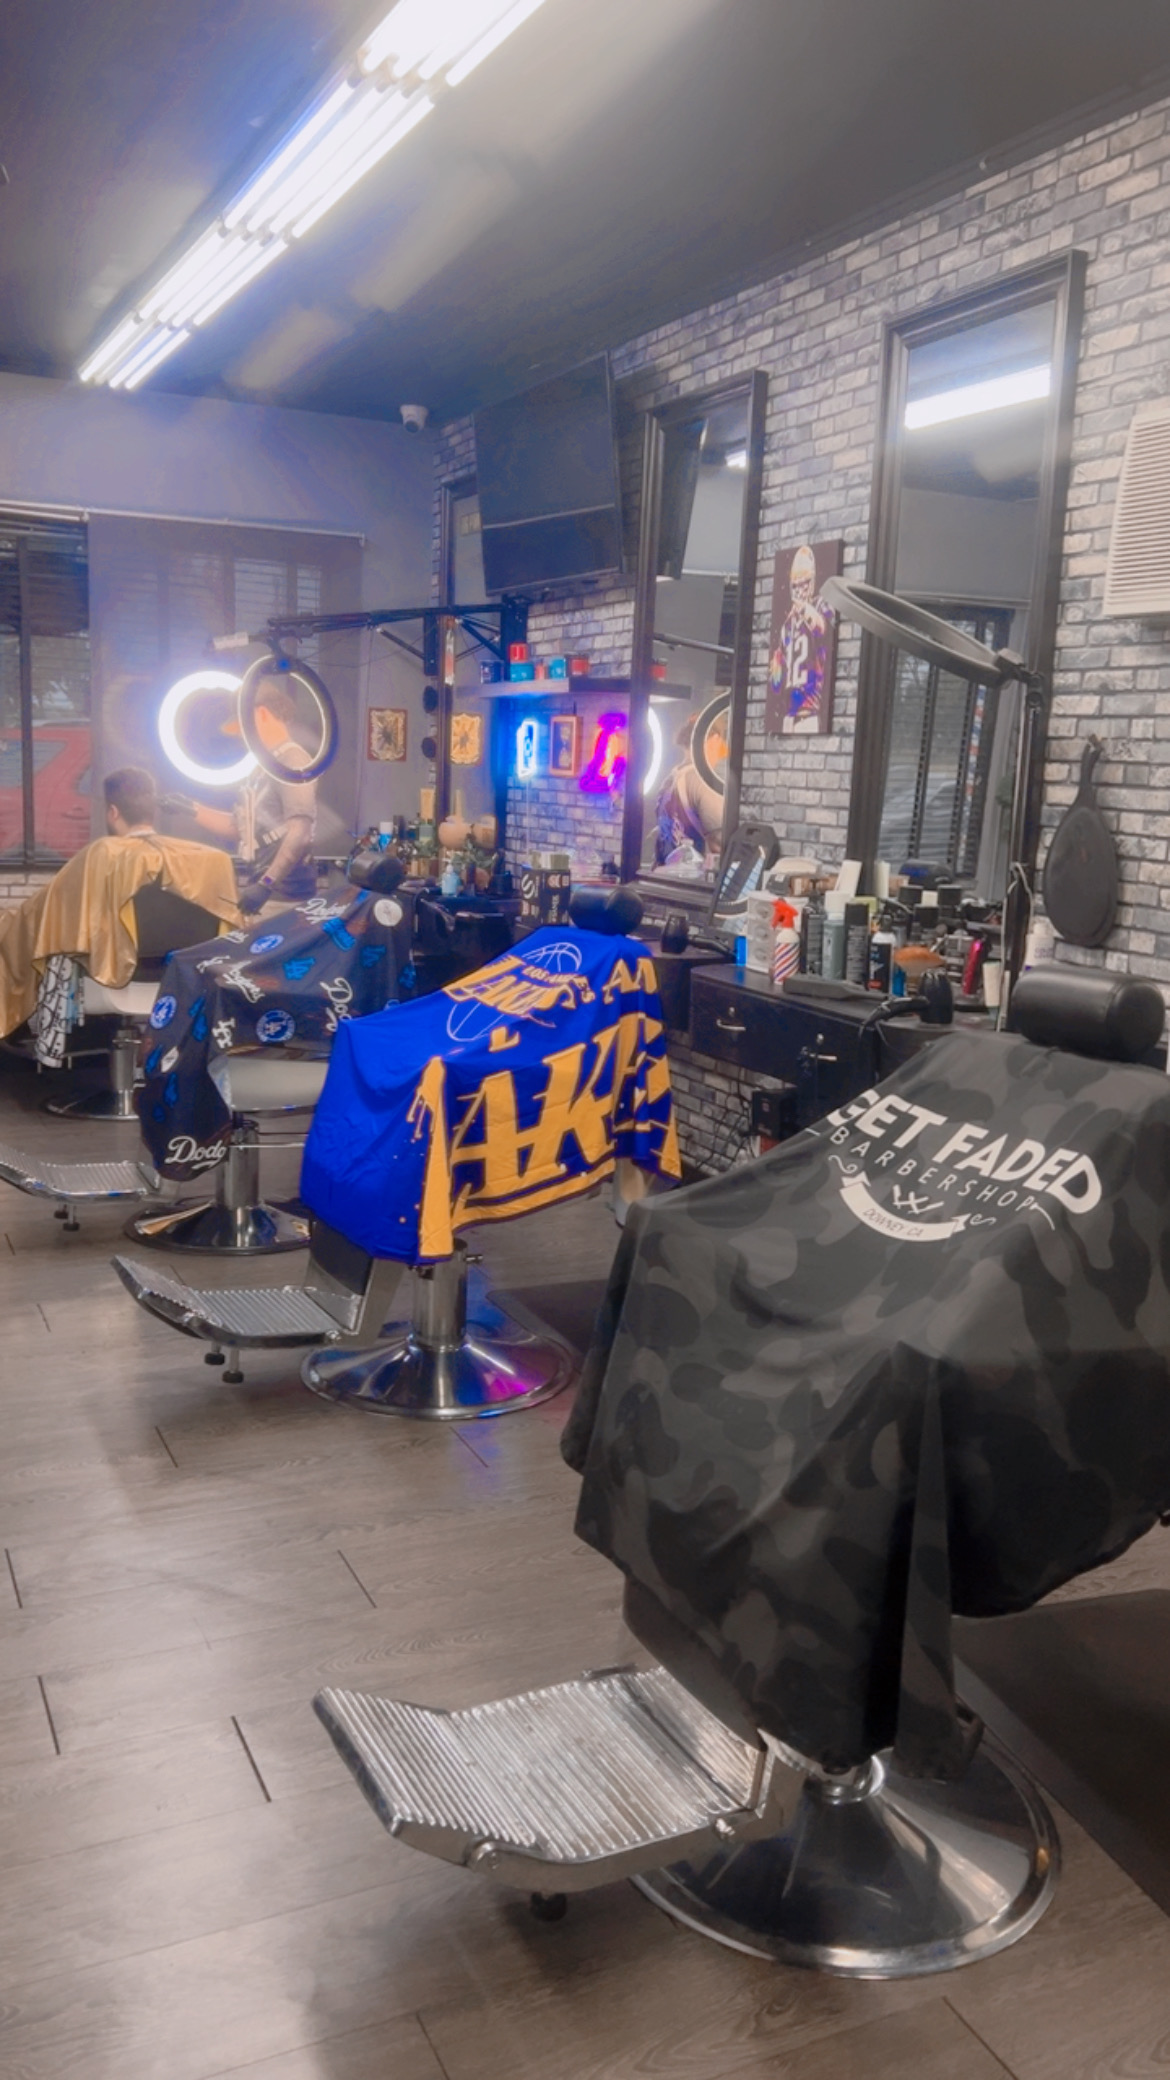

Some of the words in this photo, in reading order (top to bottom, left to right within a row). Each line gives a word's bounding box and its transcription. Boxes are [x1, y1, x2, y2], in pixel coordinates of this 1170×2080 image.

[826, 1089, 948, 1149] GET
[931, 1122, 1103, 1215] FADED
[829, 1126, 1035, 1212] BARBERSHOP
